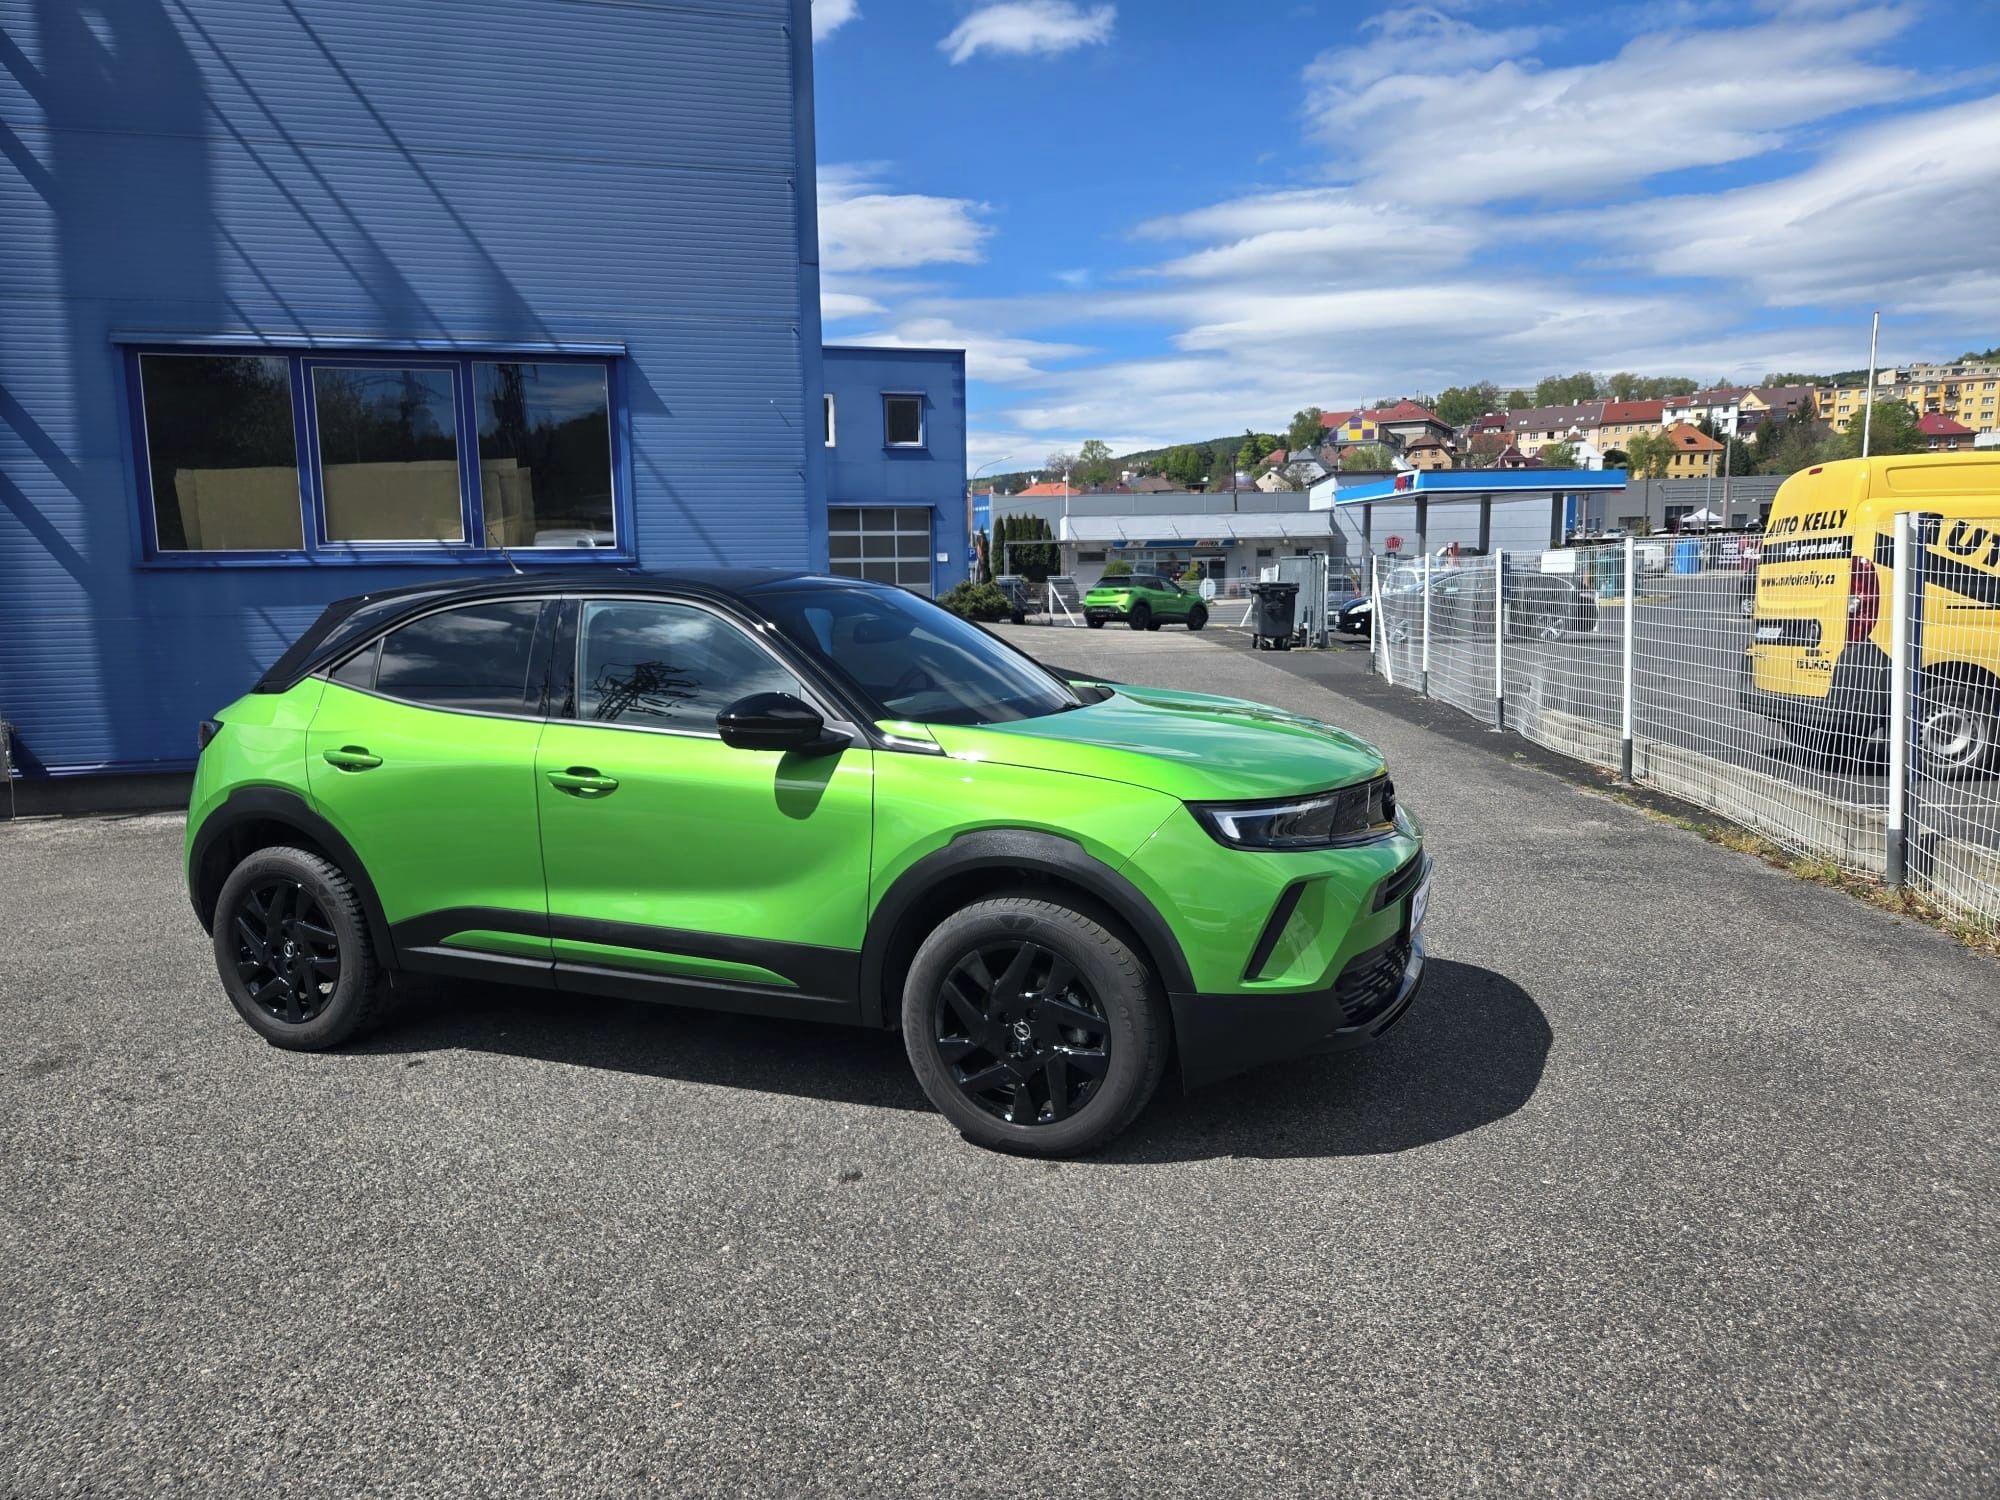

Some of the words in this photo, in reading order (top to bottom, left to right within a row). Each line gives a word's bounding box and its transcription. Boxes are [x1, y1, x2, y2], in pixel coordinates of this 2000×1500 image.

[1766, 516, 1799, 538] AUTO
[1802, 509, 1848, 532] KELLY
[969, 549, 976, 557] P
